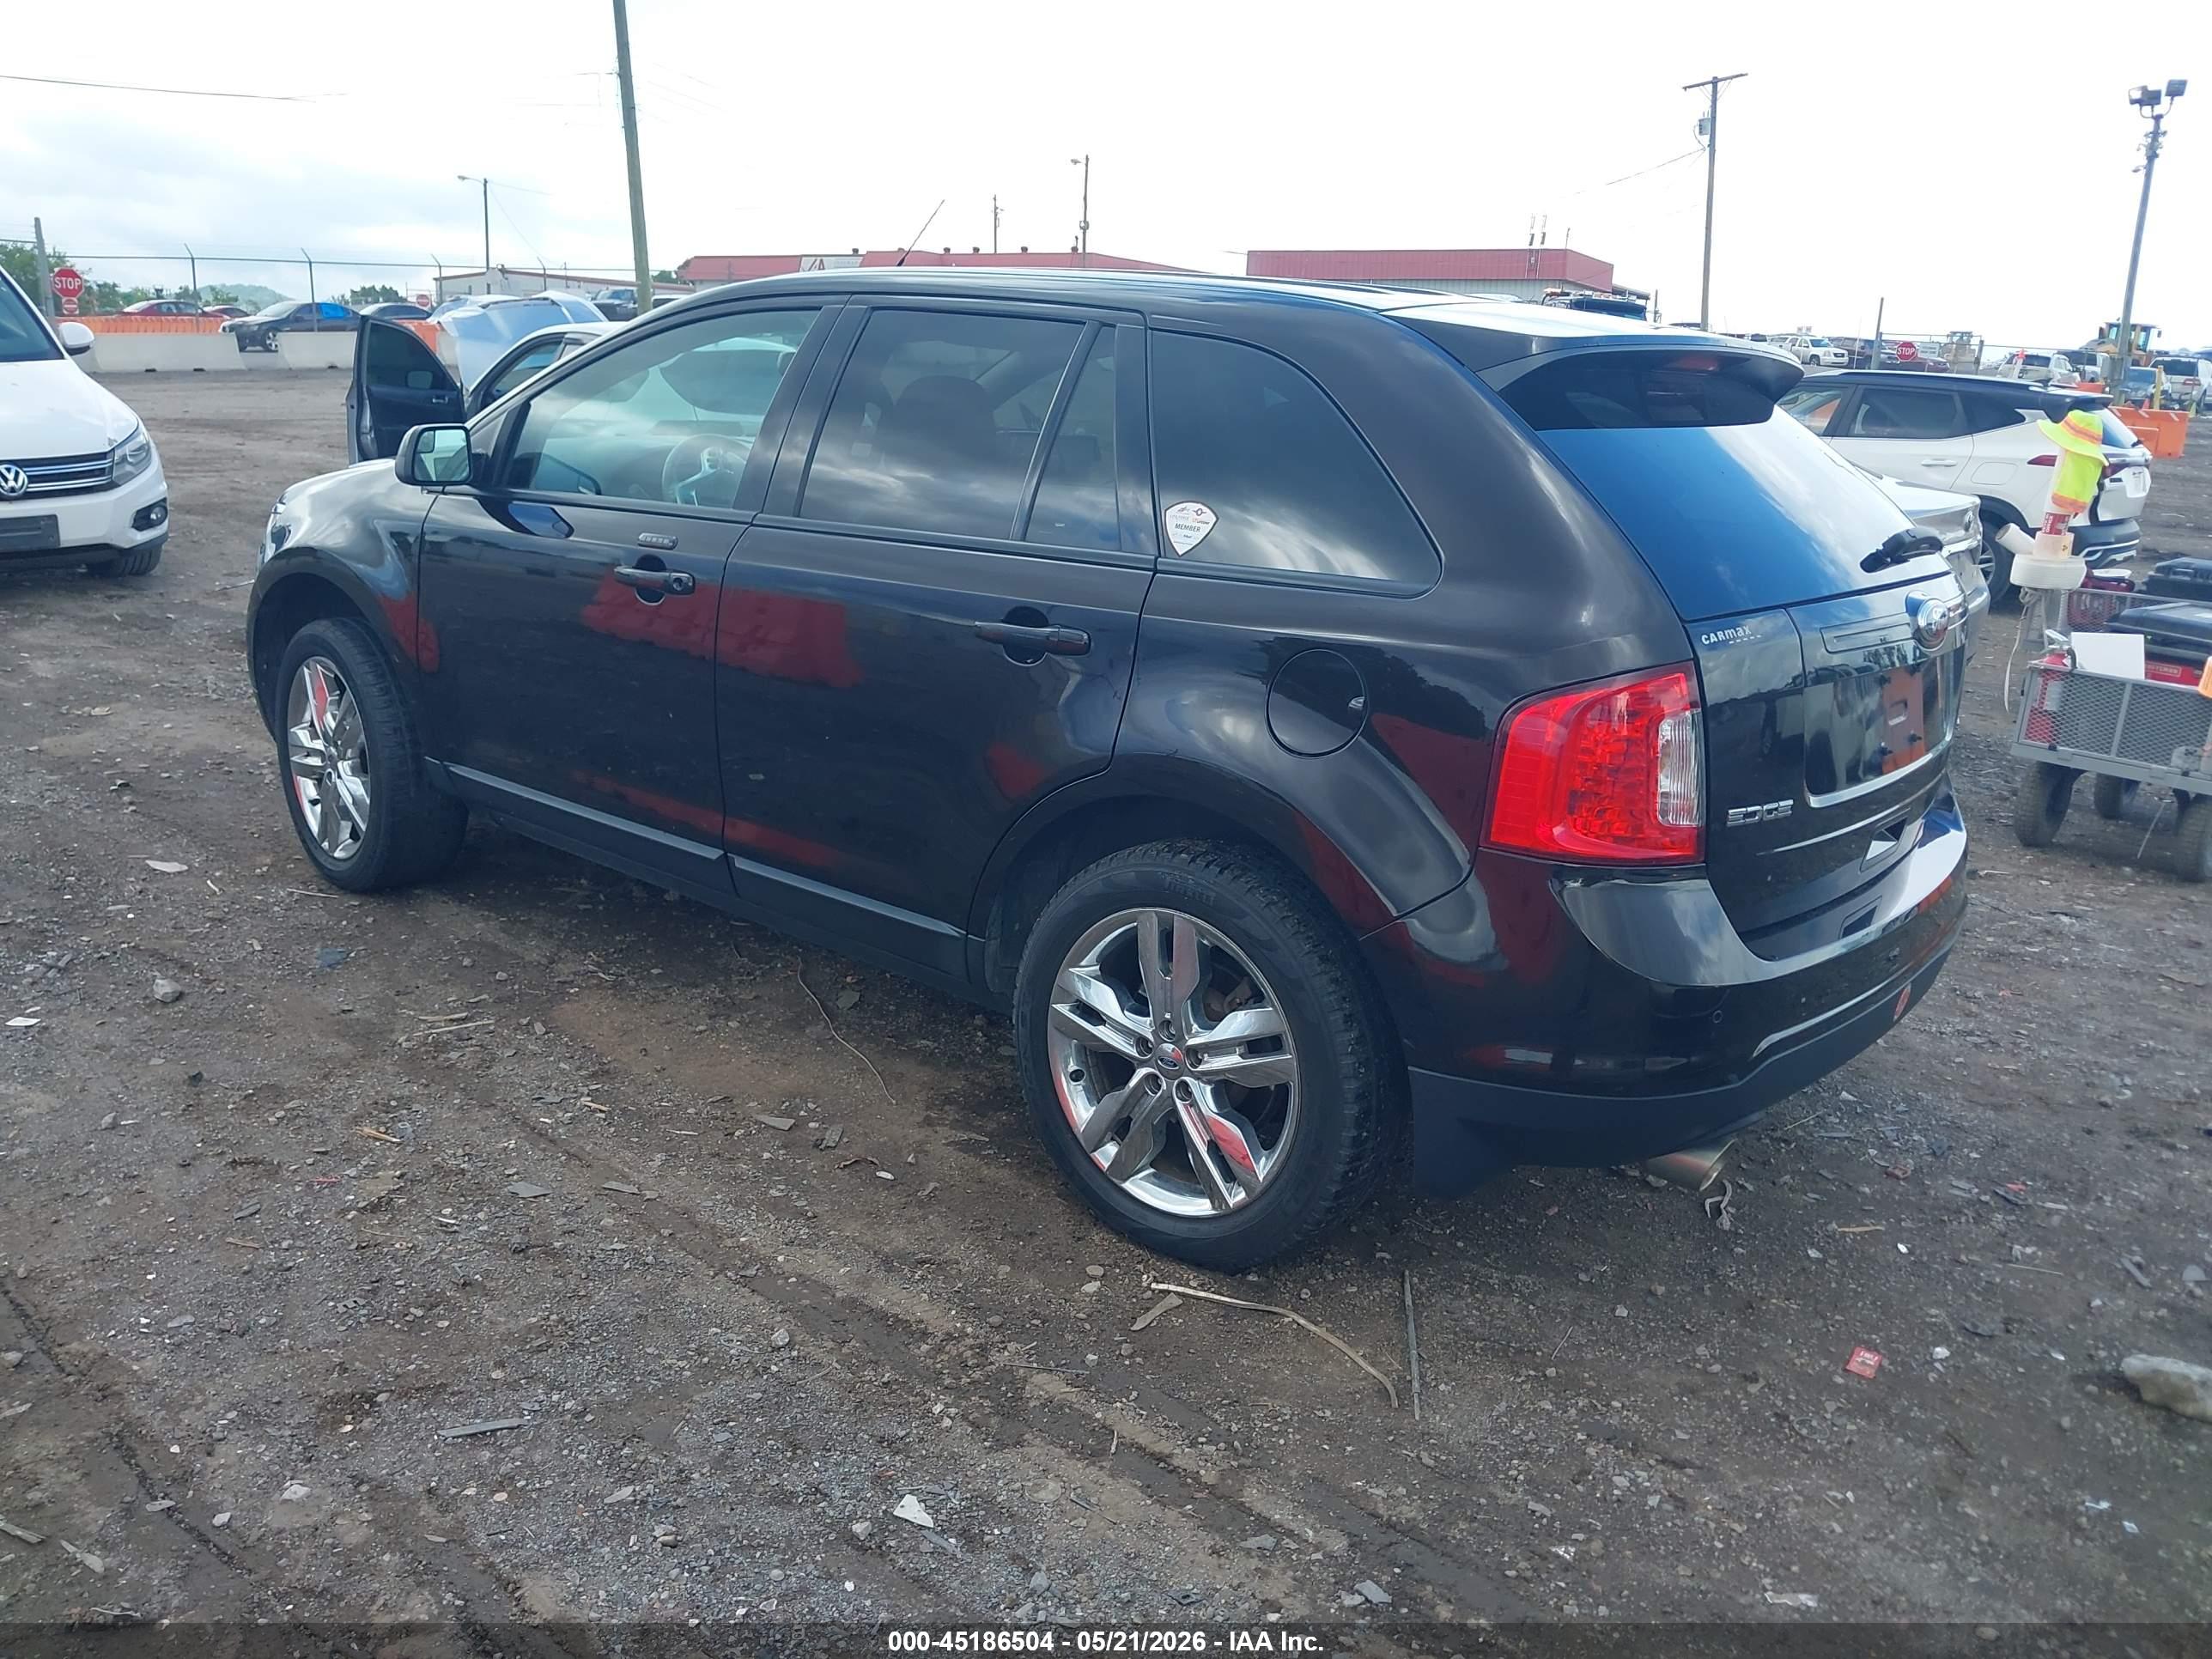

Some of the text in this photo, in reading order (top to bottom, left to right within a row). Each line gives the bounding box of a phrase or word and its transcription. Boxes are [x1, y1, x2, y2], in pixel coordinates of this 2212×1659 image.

[54, 276, 82, 290] STOP
[1897, 347, 1916, 356] STOP
[1174, 522, 1201, 533] MEMBER
[1726, 799, 1794, 828] EDGE
